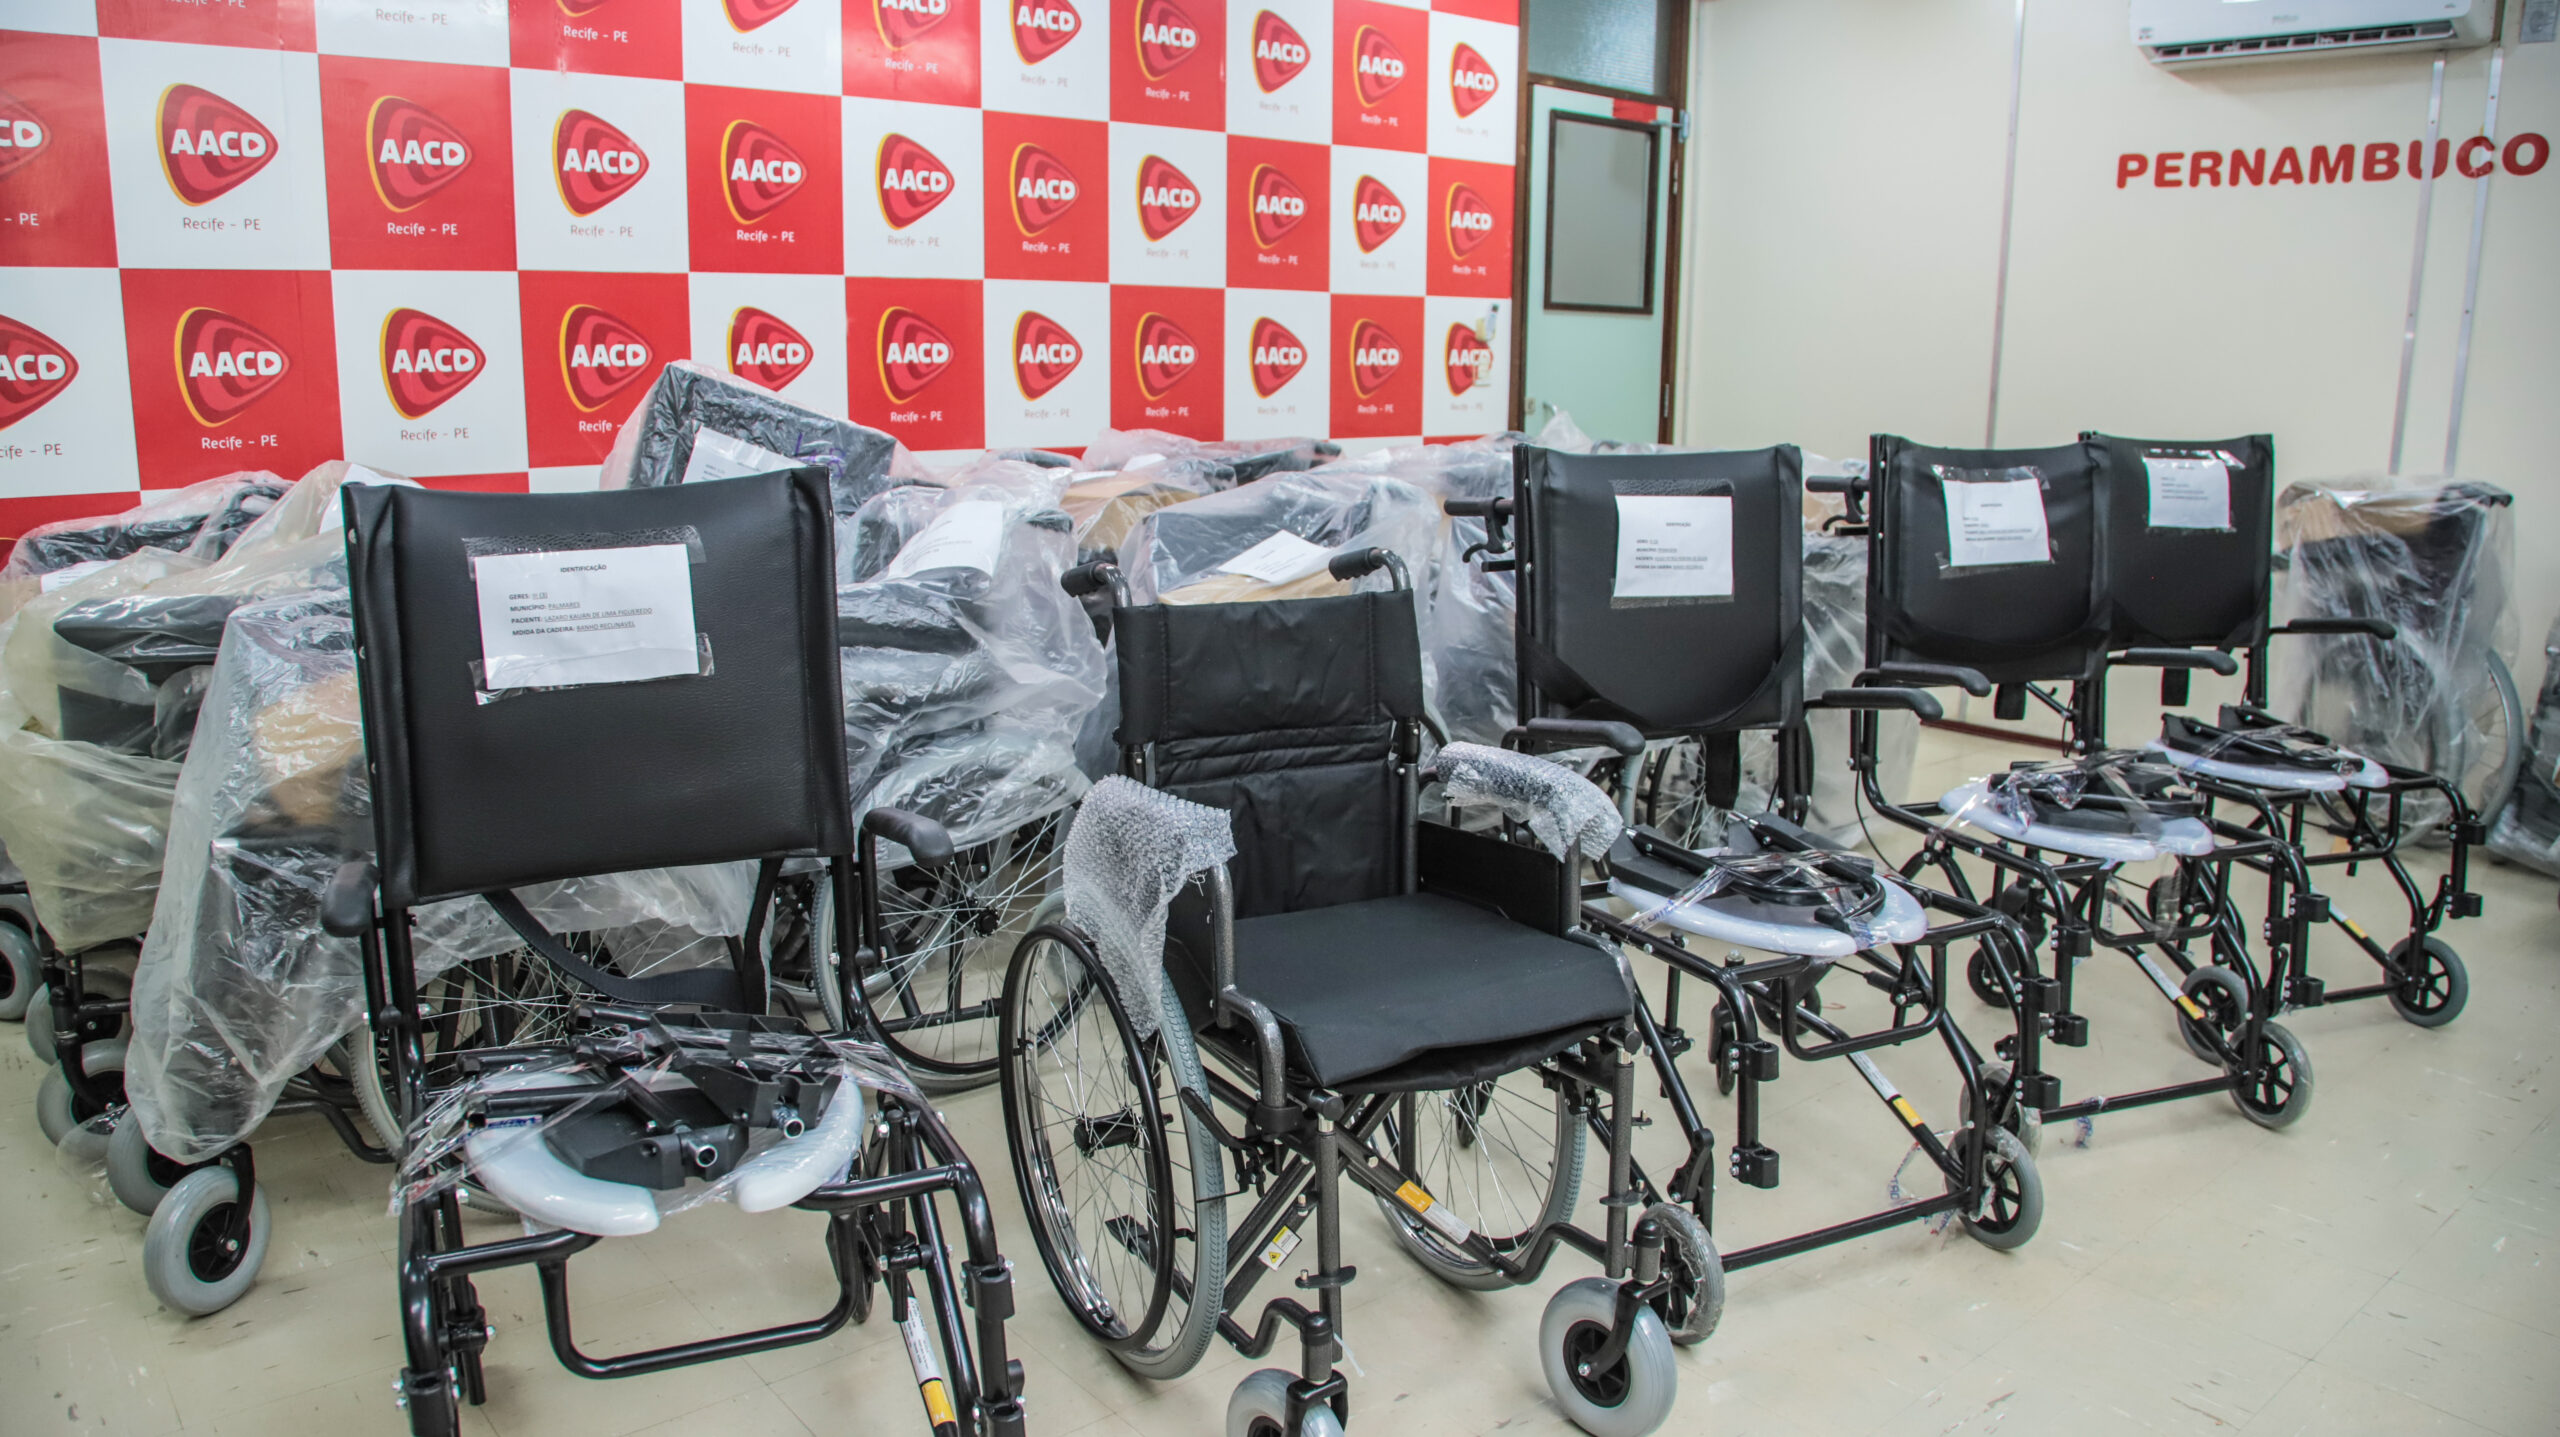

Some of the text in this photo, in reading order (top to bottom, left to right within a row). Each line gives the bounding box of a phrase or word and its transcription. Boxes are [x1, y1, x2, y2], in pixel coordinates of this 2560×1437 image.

[375, 8, 415, 25] Recife
[431, 12, 449, 26] PE
[1017, 6, 1075, 32] AACD
[563, 24, 599, 41] Recife
[613, 30, 629, 44] PE
[1143, 23, 1196, 47] AACD
[732, 41, 765, 57] Recife
[777, 45, 791, 58] PE
[1257, 39, 1305, 64] AACD
[884, 57, 915, 72] Recife
[925, 61, 939, 74] PE
[1360, 55, 1404, 77] AACD
[1454, 70, 1495, 91] AACD
[1178, 90, 1190, 102] PE
[171, 129, 267, 157] AACD
[379, 139, 465, 166] AACD
[563, 148, 640, 174] AACD
[2116, 132, 2550, 189] PERNAMBUCO
[731, 159, 801, 184] AACD
[883, 168, 948, 193] AACD
[1018, 178, 1076, 200] AACD
[1142, 186, 1195, 208] AACD
[1255, 195, 1304, 216] AACD
[1357, 203, 1402, 223] AACD
[19, 212, 39, 226] PE
[182, 216, 225, 233] Recife
[243, 218, 262, 231] PE
[1452, 211, 1492, 231] AACD
[386, 222, 426, 237] Recife
[441, 223, 459, 236] PE
[570, 224, 605, 238] Recife
[619, 225, 634, 238] PE
[736, 229, 769, 244] Recife
[781, 230, 796, 243] PE
[887, 234, 917, 248] Recife
[927, 236, 940, 248] PE
[1021, 240, 1049, 255] Recife
[1058, 242, 1070, 254] PE
[392, 347, 476, 373] AACD
[571, 344, 646, 367] AACD
[736, 344, 806, 365] AACD
[886, 343, 949, 364] AACD
[1019, 343, 1076, 364] AACD
[1142, 345, 1195, 364] AACD
[1254, 346, 1303, 365] AACD
[1356, 348, 1400, 366] AACD
[0, 354, 66, 381] ACD
[189, 351, 282, 377] AACD
[890, 410, 918, 425] Recife
[930, 410, 943, 423] PE
[1177, 406, 1189, 418] PE
[400, 428, 438, 442] Recife
[453, 427, 470, 439] PE
[578, 419, 613, 433] Recife
[44, 443, 63, 456] PE
[201, 435, 243, 451] Recife
[260, 434, 279, 447] PE
[560, 563, 607, 573] IDENTIFICAÇÃO
